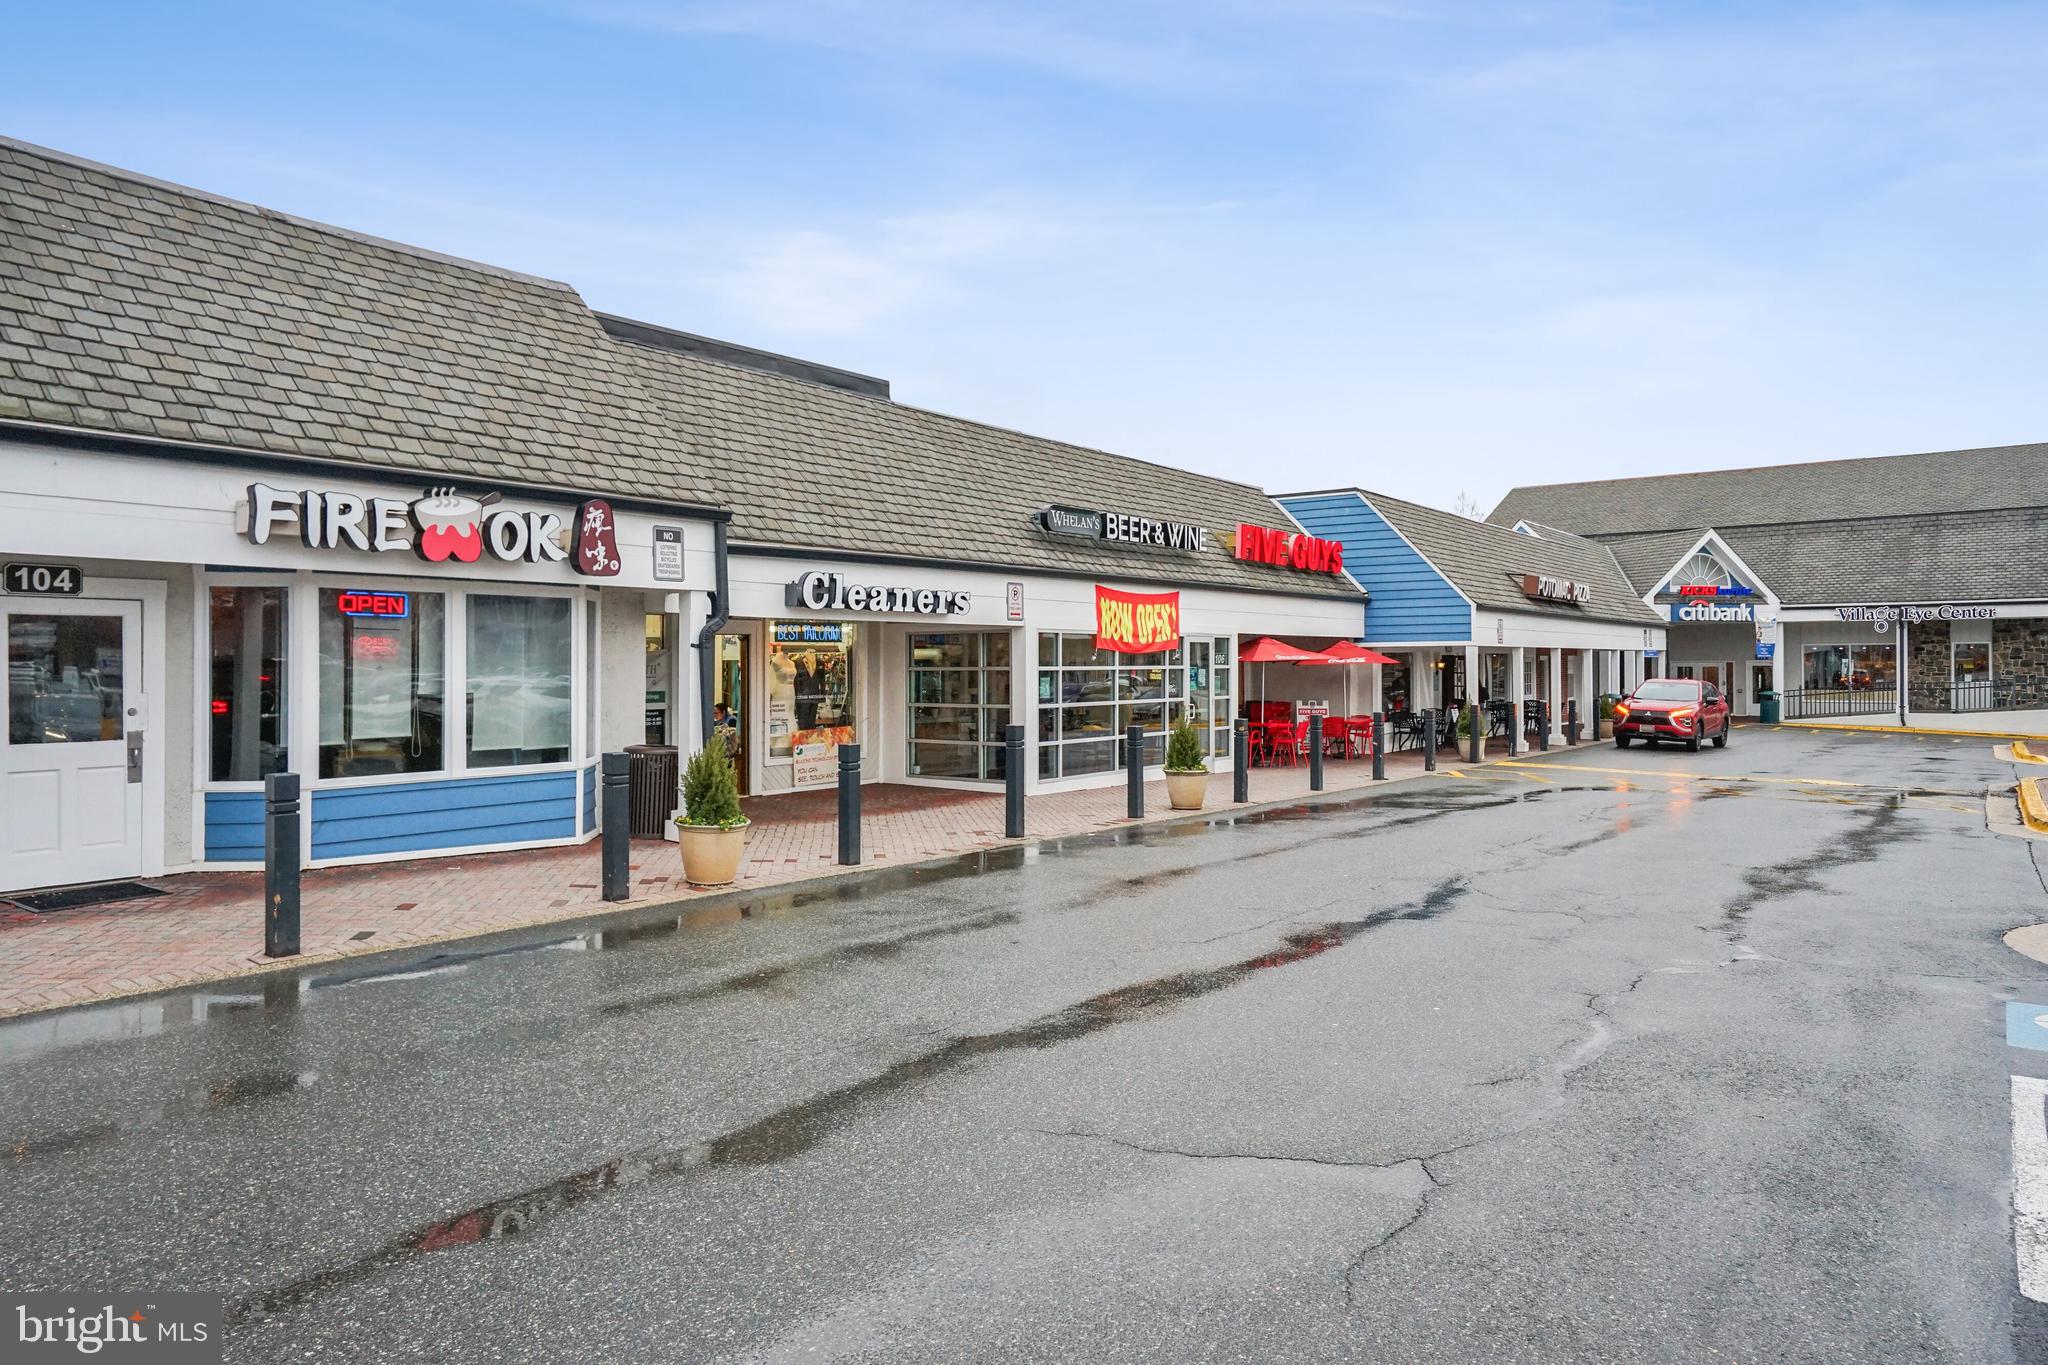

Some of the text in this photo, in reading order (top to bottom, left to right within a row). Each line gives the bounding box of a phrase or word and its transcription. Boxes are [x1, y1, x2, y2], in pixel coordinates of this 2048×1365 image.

[254, 484, 412, 552] FIRE
[663, 532, 674, 541] NO
[1106, 513, 1151, 543] BEER
[1154, 523, 1165, 544] &
[1167, 523, 1208, 550] WINE
[1236, 523, 1344, 574] FIVE GUYS
[15, 567, 73, 592] 104
[1538, 576, 1571, 600] POTOMAC
[339, 595, 404, 614] OPEN
[802, 571, 972, 616] Cleaners
[1101, 597, 1178, 644] NOW OPEN!
[1679, 602, 1752, 622] citibank
[1836, 605, 1997, 633] Village Eye Center
[777, 624, 799, 640] BEST
